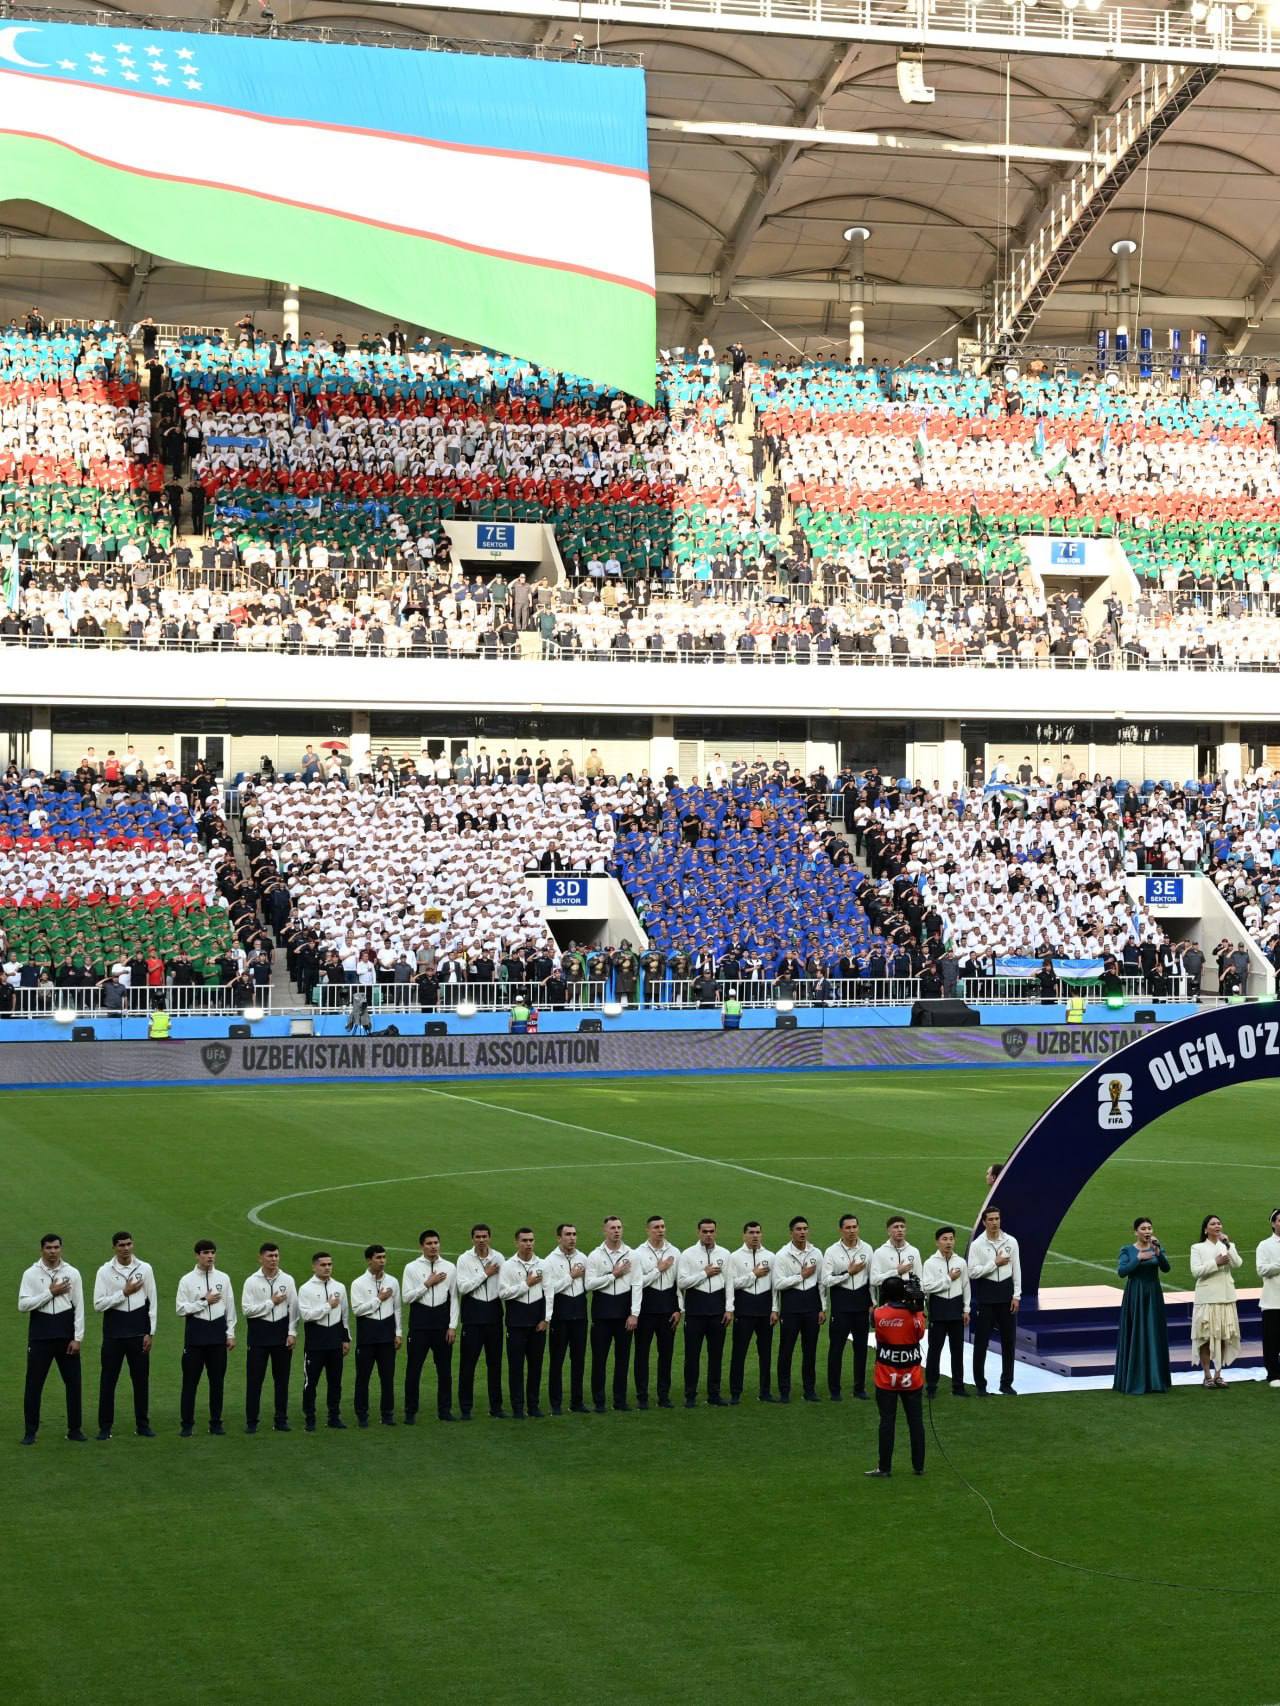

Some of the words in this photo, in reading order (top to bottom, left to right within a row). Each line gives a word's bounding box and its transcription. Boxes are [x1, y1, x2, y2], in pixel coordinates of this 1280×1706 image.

[485, 526, 506, 540] 7E
[1058, 543, 1078, 556] 7F
[555, 881, 580, 896] 3D
[1153, 880, 1175, 895] 3E
[206, 1047, 226, 1060] UFA
[242, 1044, 368, 1070] UZBEKISTAN
[371, 1042, 470, 1068] FOOTBALL
[475, 1039, 600, 1066] ASSOCIATION
[880, 1347, 921, 1362] MEDIA
[889, 1372, 912, 1387] 18
